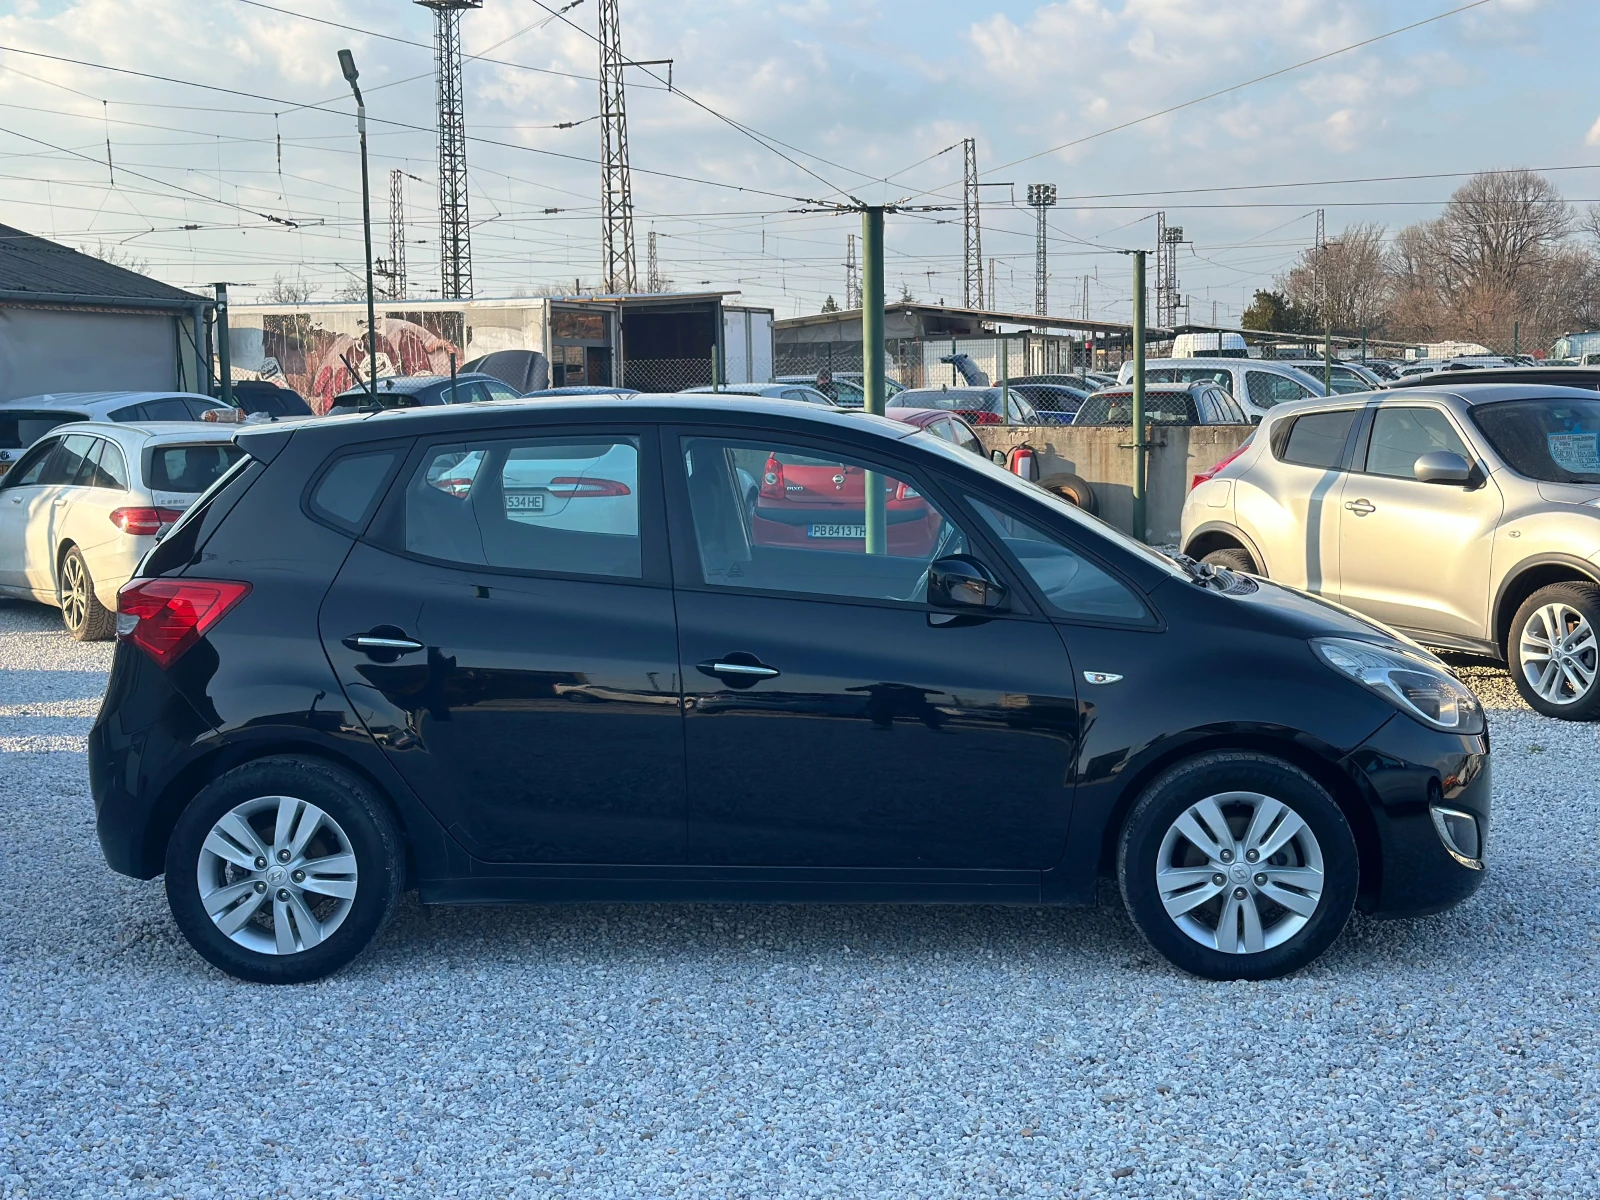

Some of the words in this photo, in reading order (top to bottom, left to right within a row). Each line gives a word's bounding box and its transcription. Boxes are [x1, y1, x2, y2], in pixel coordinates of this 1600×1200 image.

[527, 496, 541, 507] HE
[813, 525, 827, 536] PB
[828, 525, 852, 536] 8413
[853, 526, 866, 536] TH
